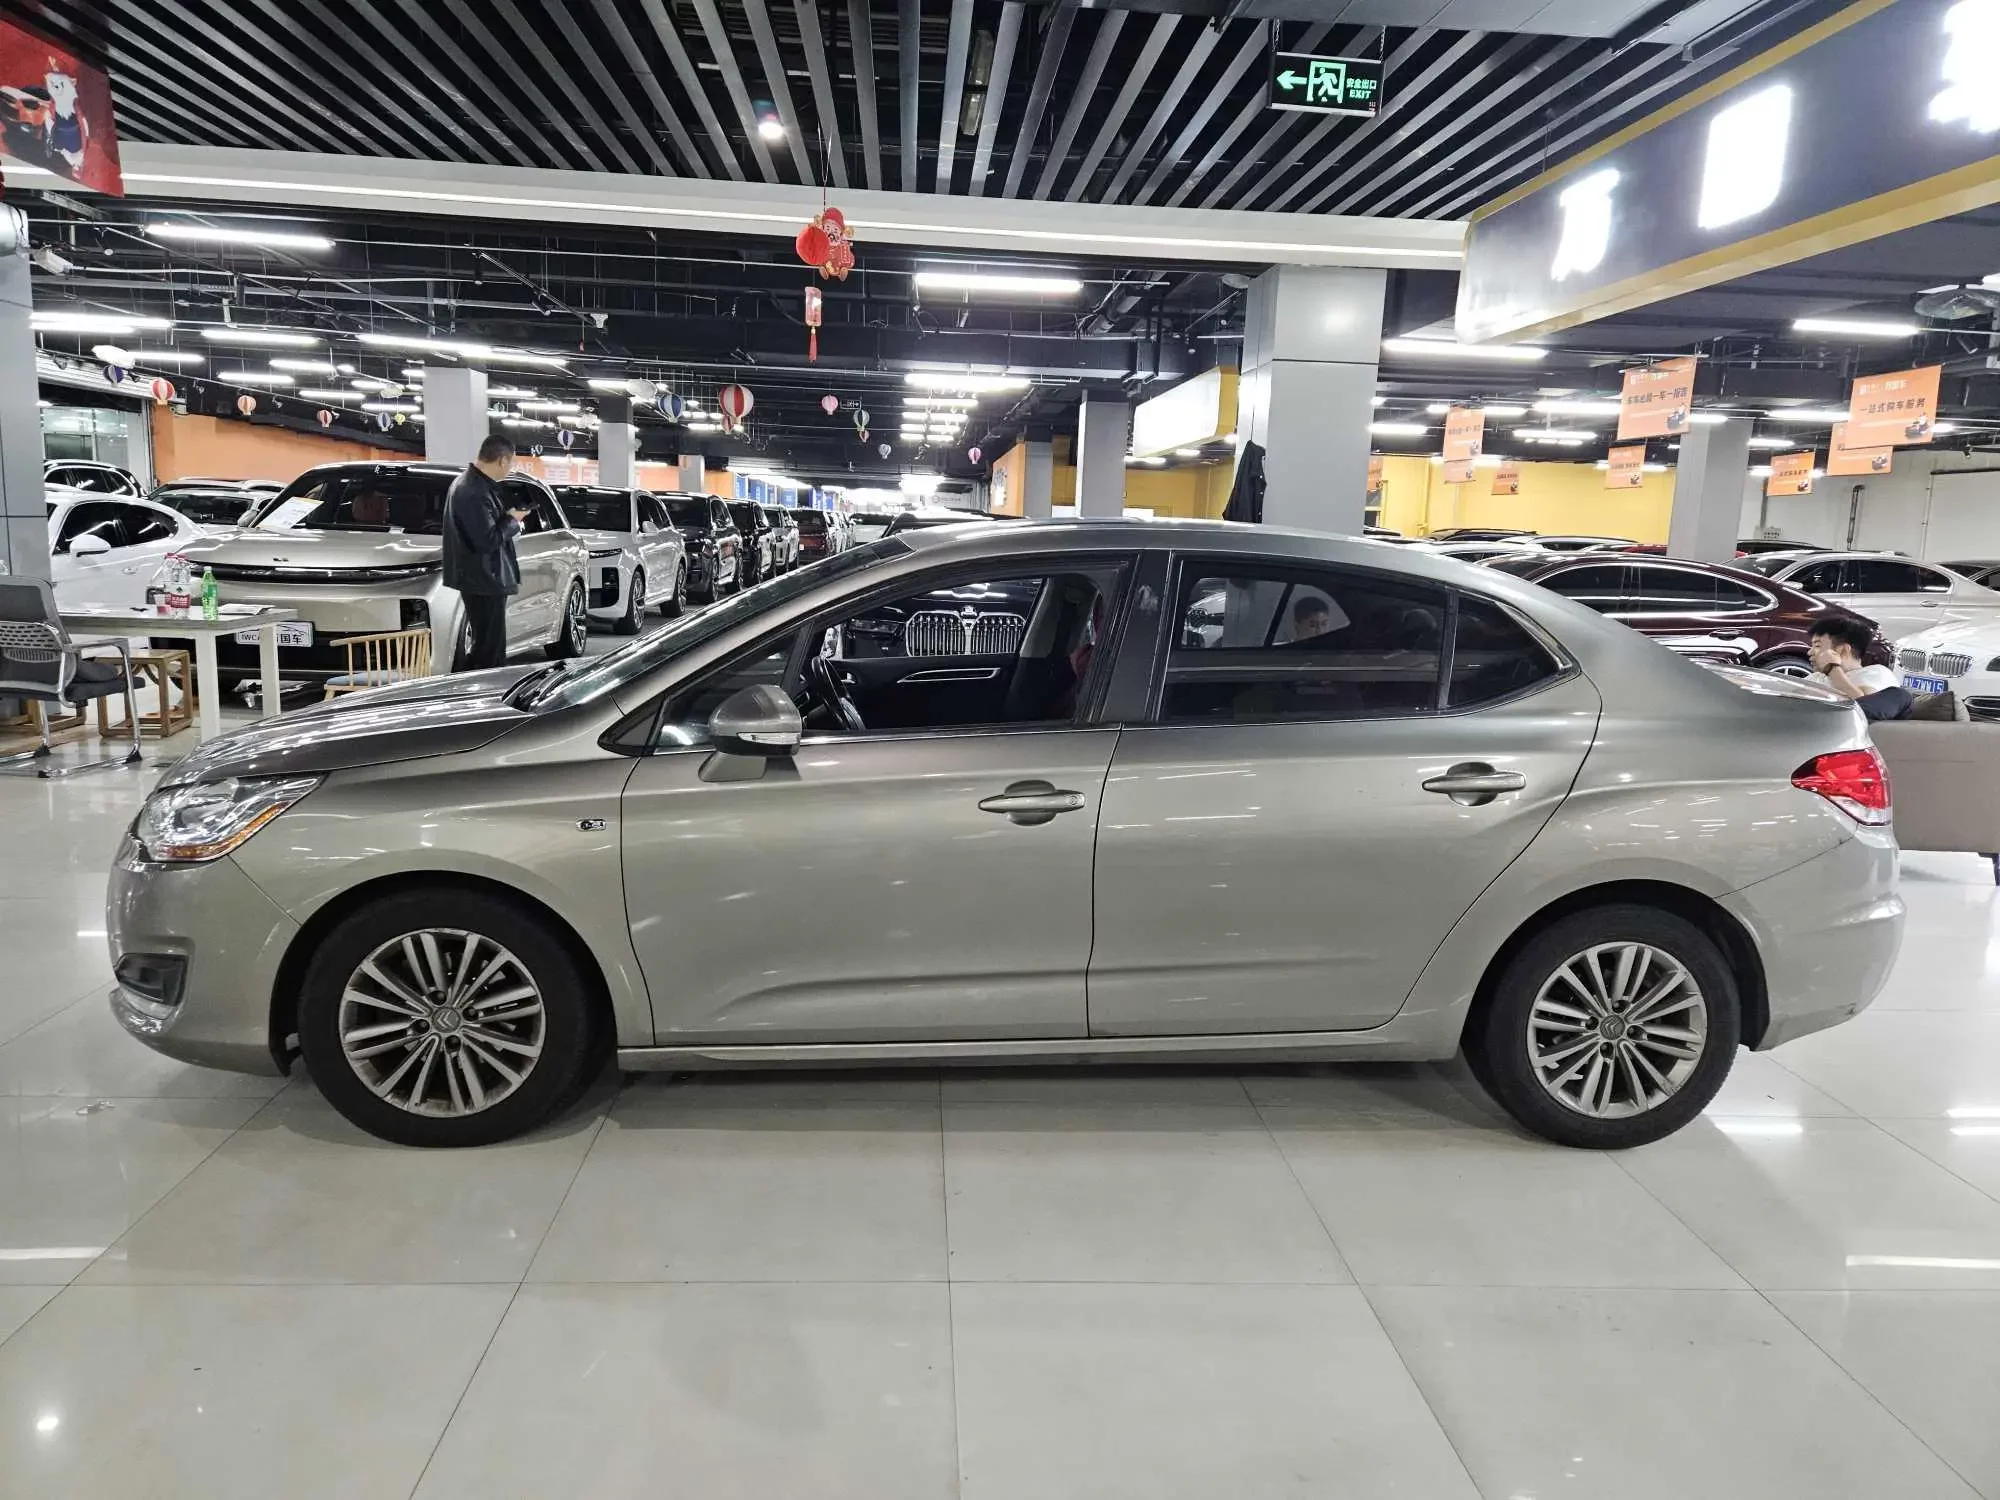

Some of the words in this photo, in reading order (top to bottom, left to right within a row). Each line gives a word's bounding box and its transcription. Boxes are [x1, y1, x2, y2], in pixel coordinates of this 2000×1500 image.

[1346, 78, 1377, 89] 安全出口
[1349, 89, 1371, 99] EXIT
